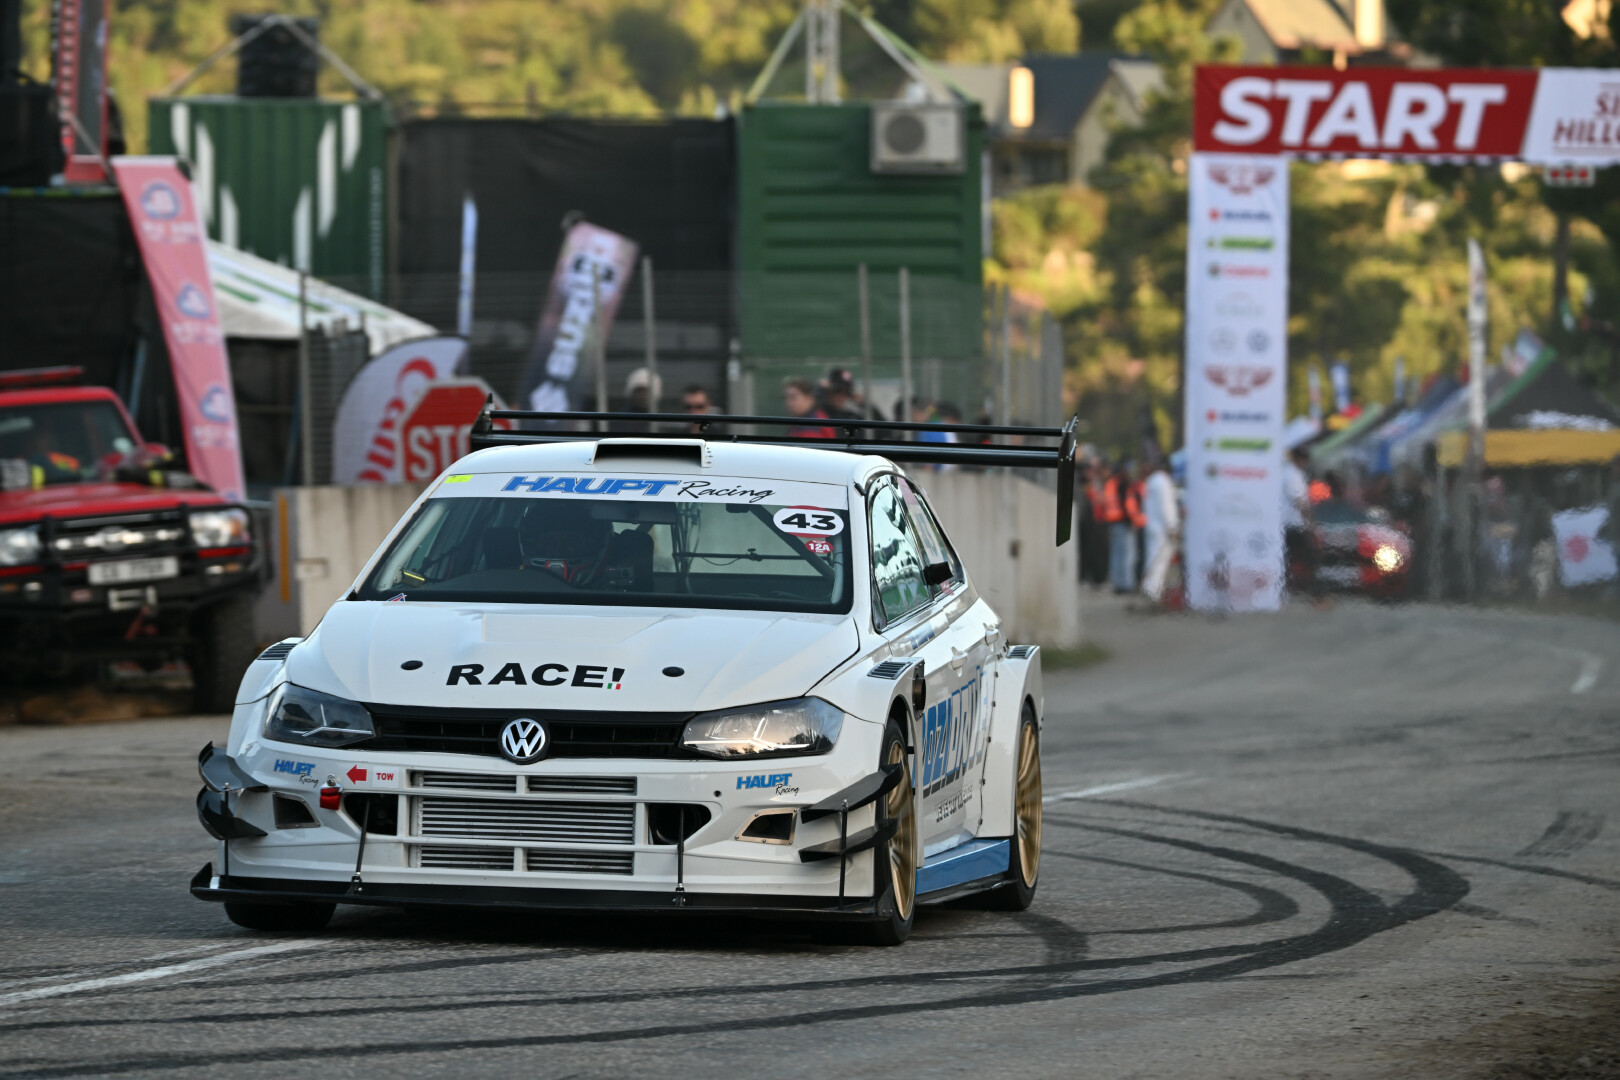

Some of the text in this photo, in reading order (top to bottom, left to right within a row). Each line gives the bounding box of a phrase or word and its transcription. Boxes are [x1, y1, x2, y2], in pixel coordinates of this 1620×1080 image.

[1212, 76, 1507, 150] START
[1552, 118, 1620, 144] HILL
[408, 424, 472, 480] ST
[501, 475, 776, 503] HAUPT Racing
[781, 513, 836, 530] 43
[808, 543, 831, 553] 12A
[446, 662, 626, 690] RACE!
[273, 759, 317, 777] HAUPT
[376, 772, 394, 781] TOW
[736, 772, 793, 790] HAUPT
[775, 783, 800, 797] Racing
